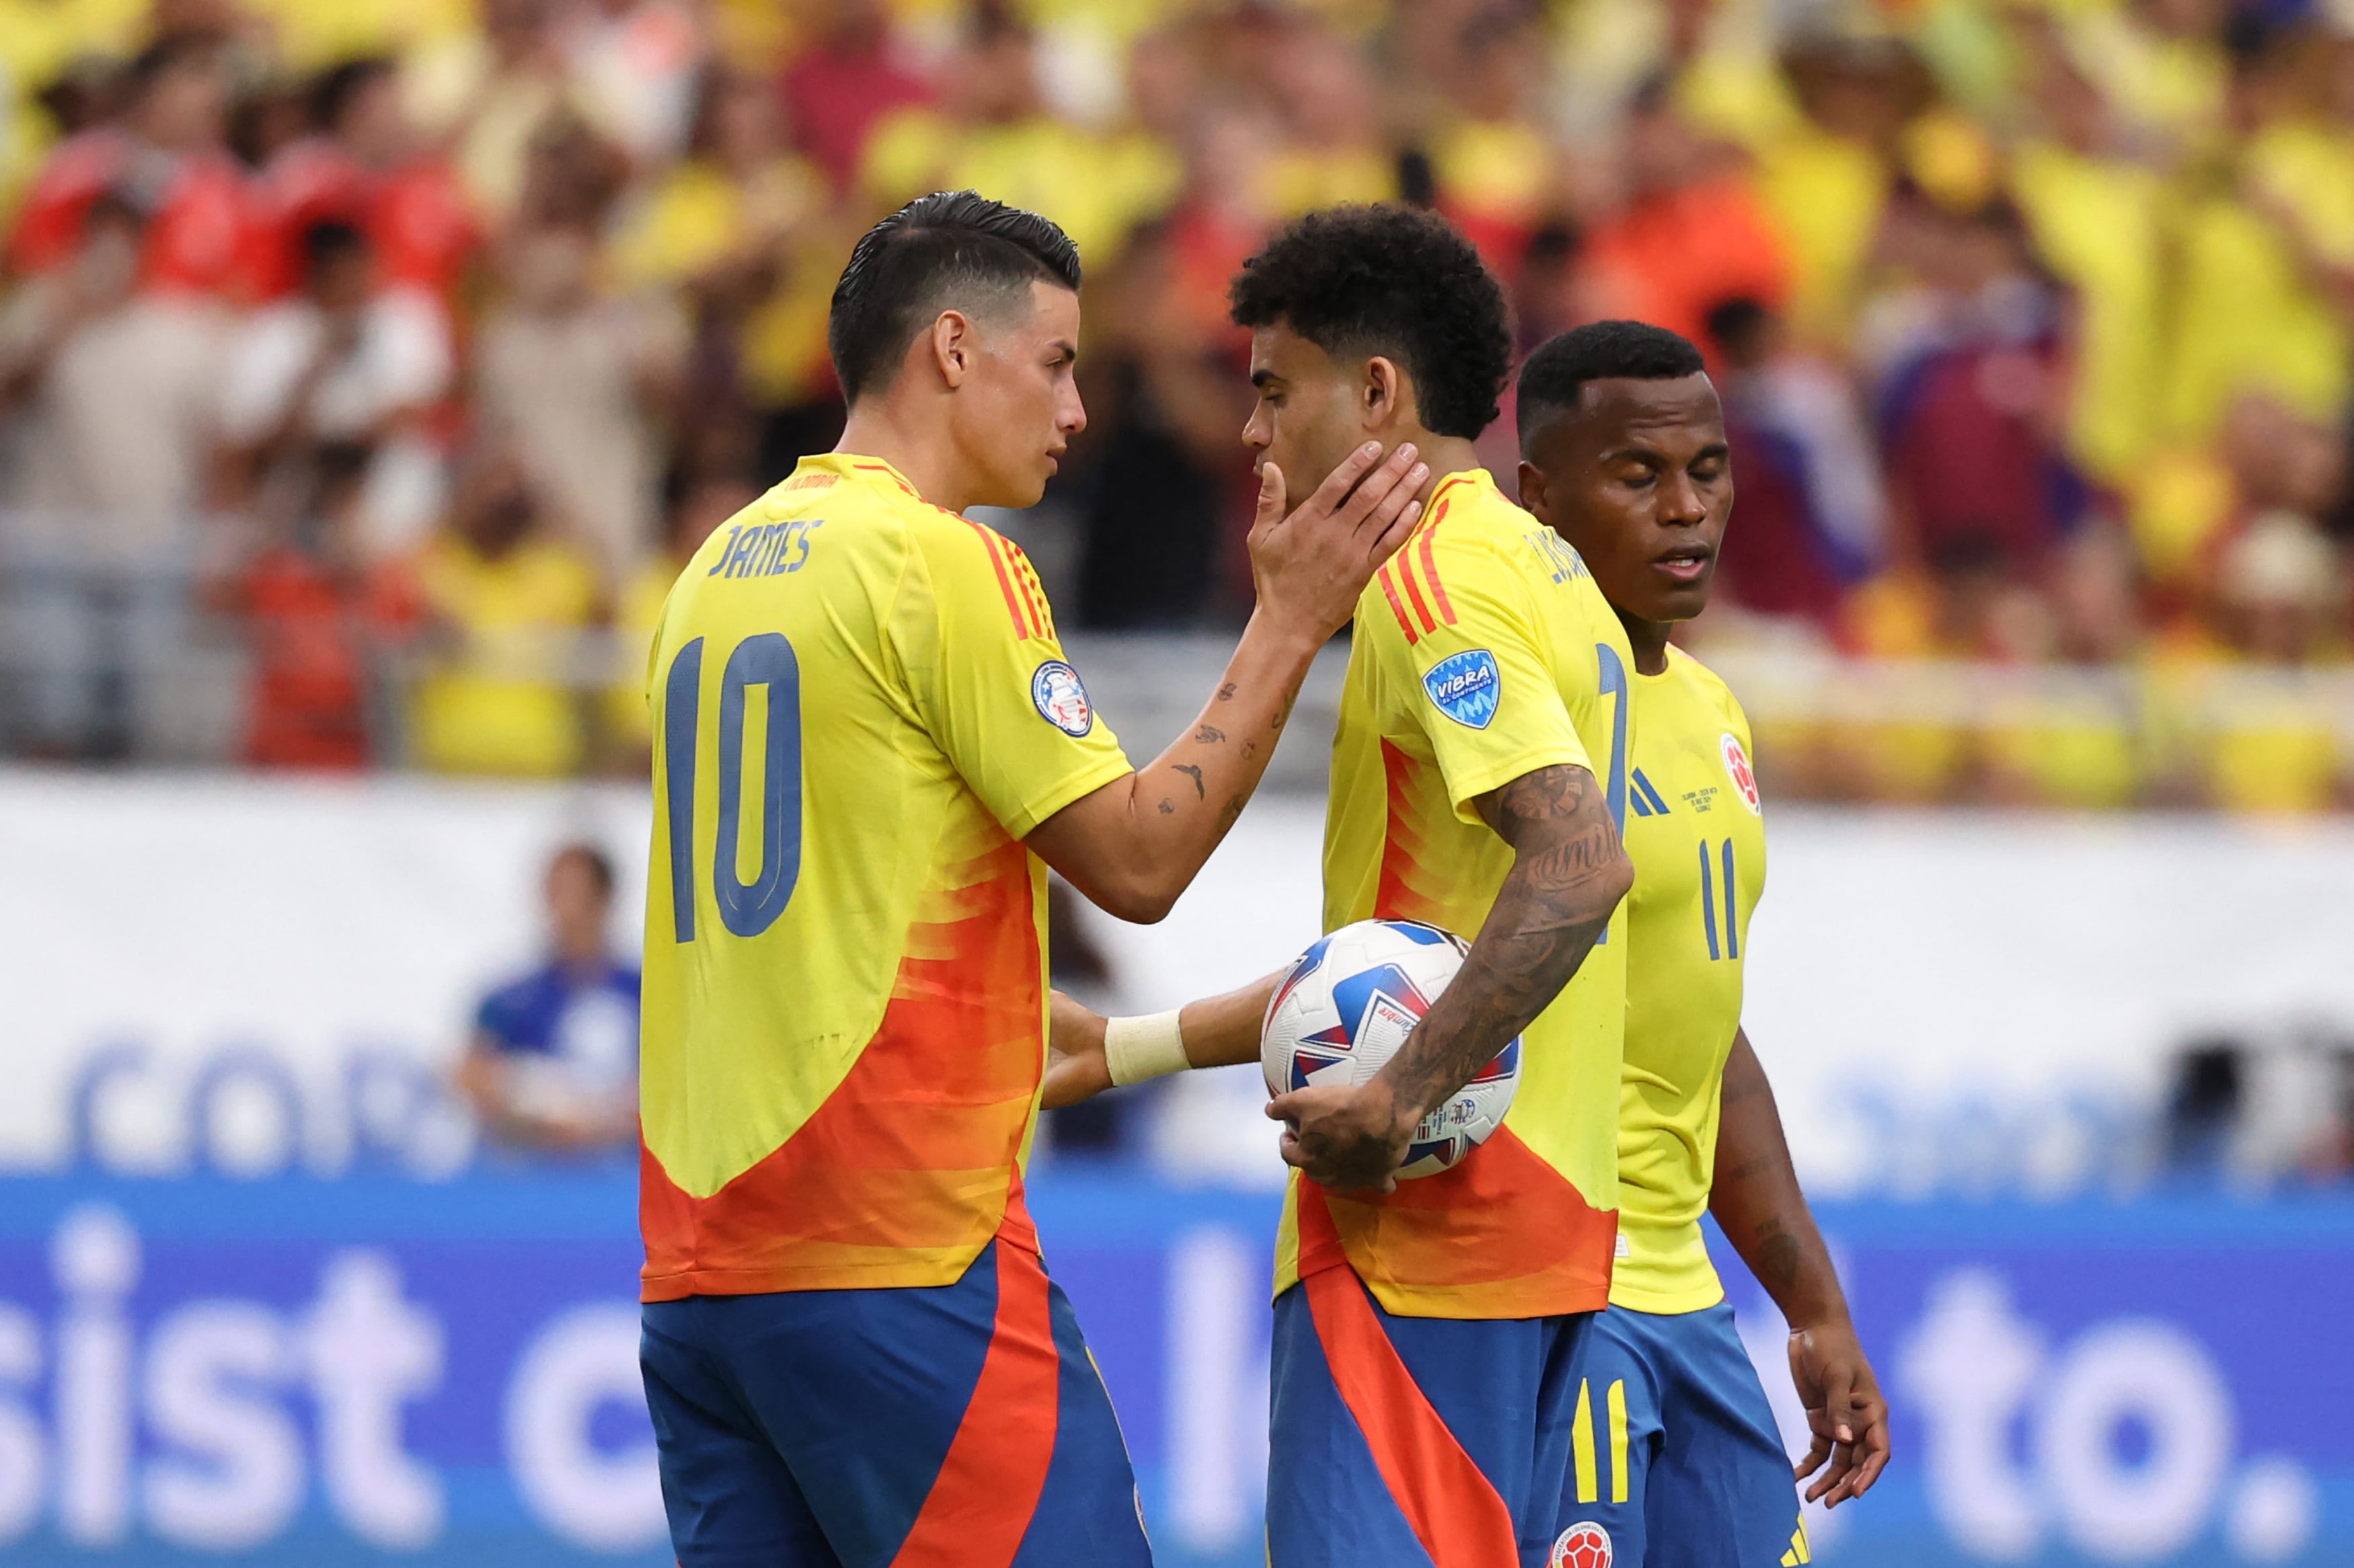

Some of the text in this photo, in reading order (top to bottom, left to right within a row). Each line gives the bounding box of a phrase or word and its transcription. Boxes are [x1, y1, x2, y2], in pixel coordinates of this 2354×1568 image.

[708, 520, 825, 578] JAMES
[1437, 665, 1490, 698] VIBRA
[665, 631, 802, 944] 10
[1699, 838, 1738, 961] 11
[0, 1207, 444, 1552] ist
[1571, 1377, 1629, 1503] 11
